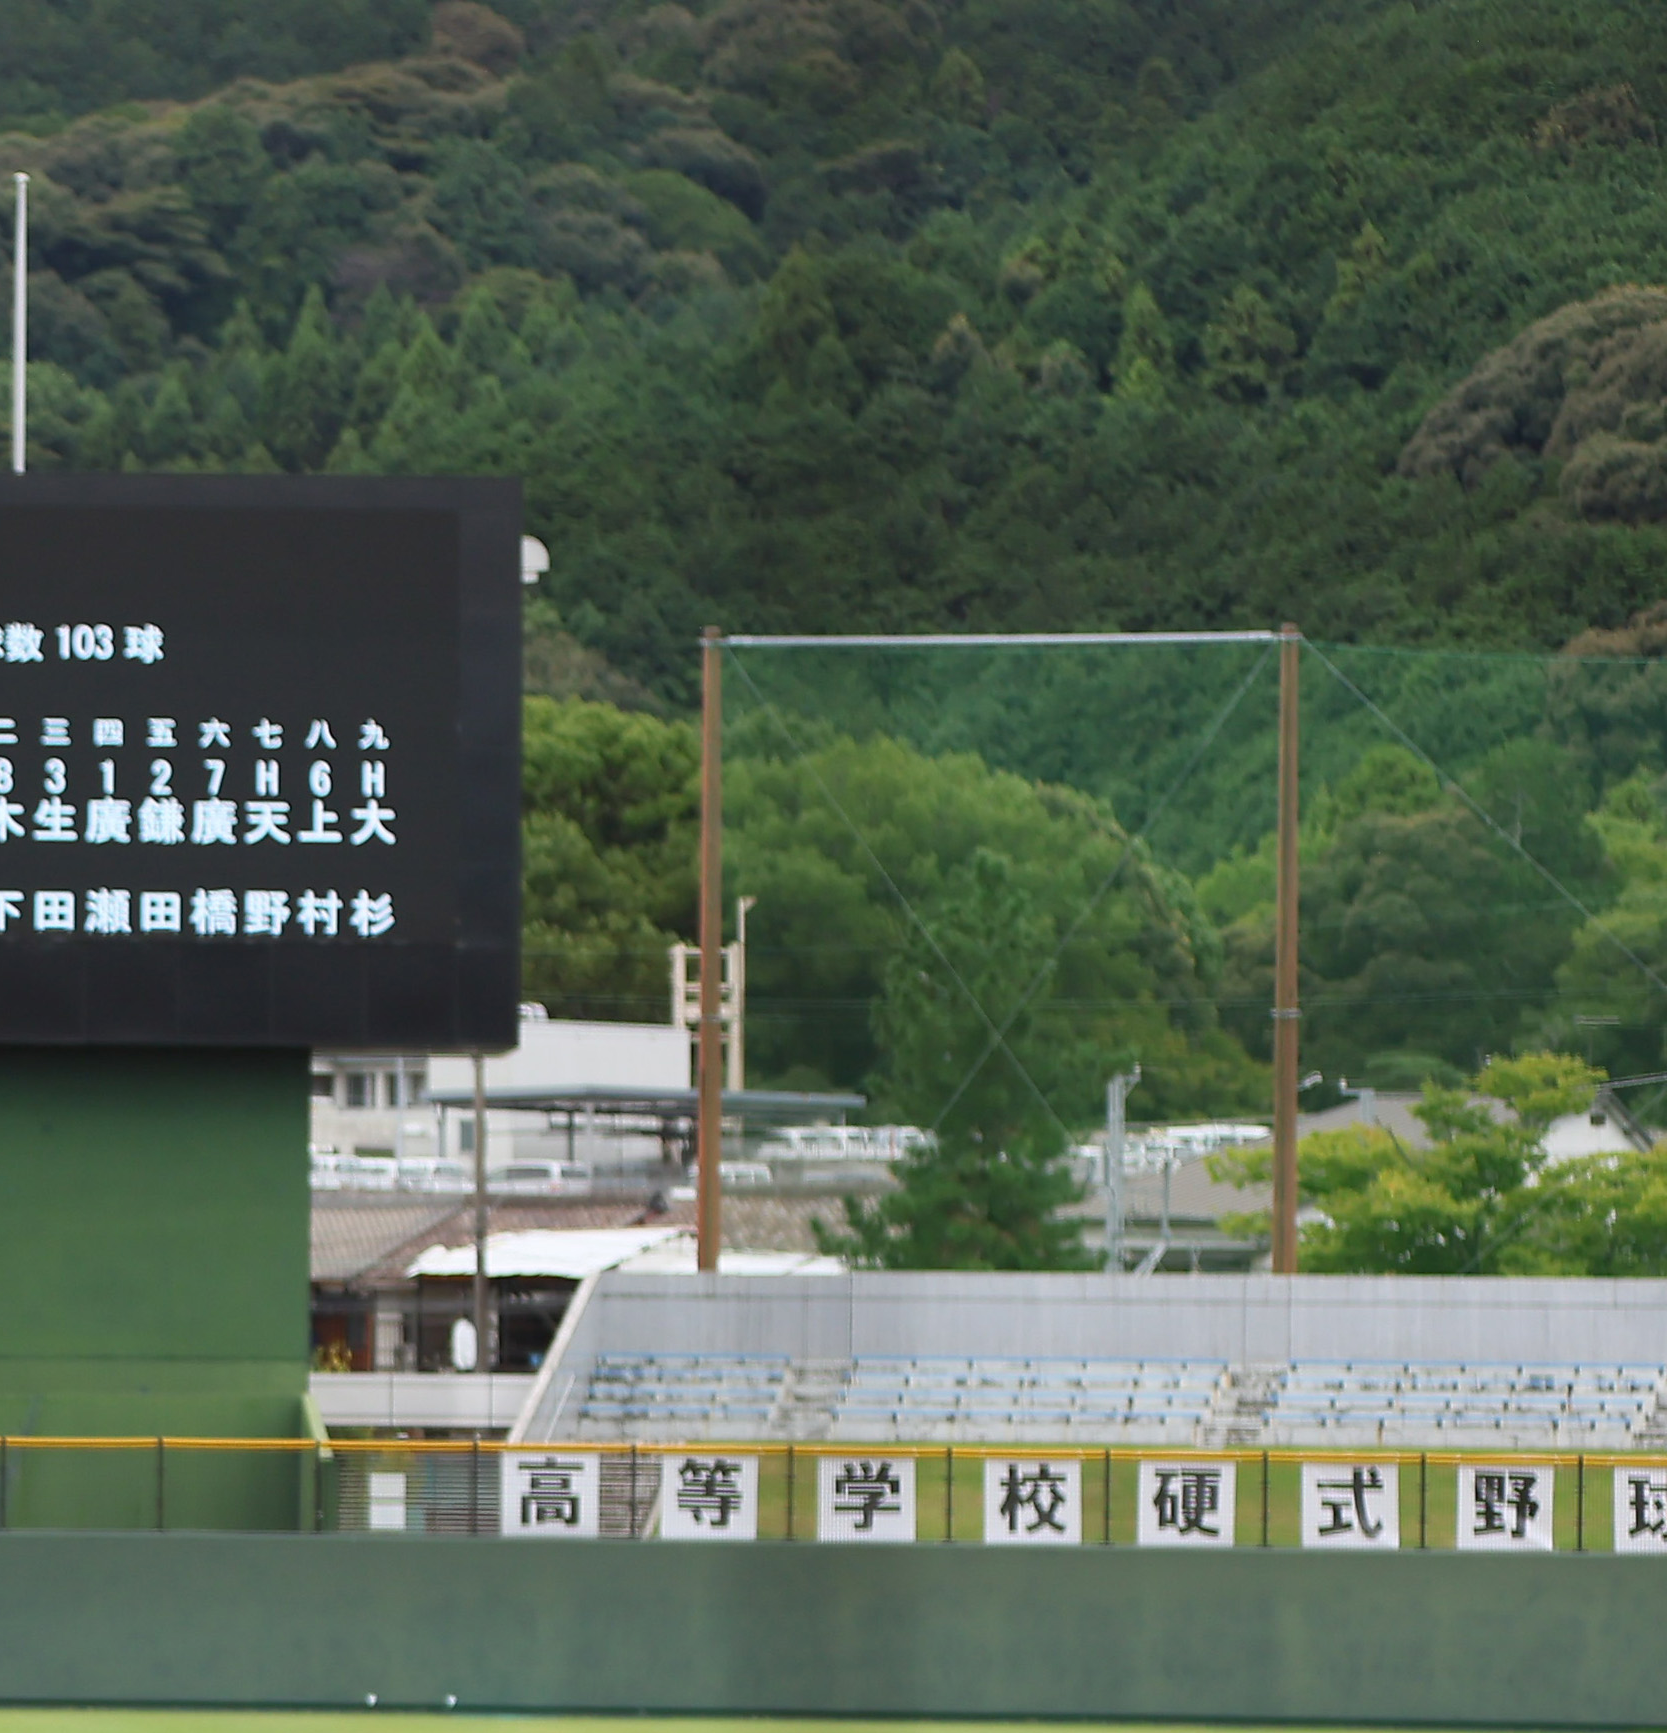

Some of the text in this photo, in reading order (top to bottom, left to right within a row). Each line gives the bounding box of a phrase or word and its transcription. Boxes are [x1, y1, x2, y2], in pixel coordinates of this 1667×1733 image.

[55, 623, 115, 661] 103
[122, 623, 164, 665] 球
[40, 717, 72, 746] 三
[92, 718, 124, 747] 四
[146, 717, 178, 748] 五
[198, 717, 231, 749] 六
[252, 717, 284, 750] 七
[304, 719, 337, 749] 八
[358, 718, 390, 750] 九
[43, 757, 67, 795] 3
[99, 758, 115, 795] 1
[149, 758, 173, 796] 2
[204, 758, 226, 796] 7
[255, 759, 279, 797] H
[308, 759, 332, 797] 6
[361, 760, 385, 797] H
